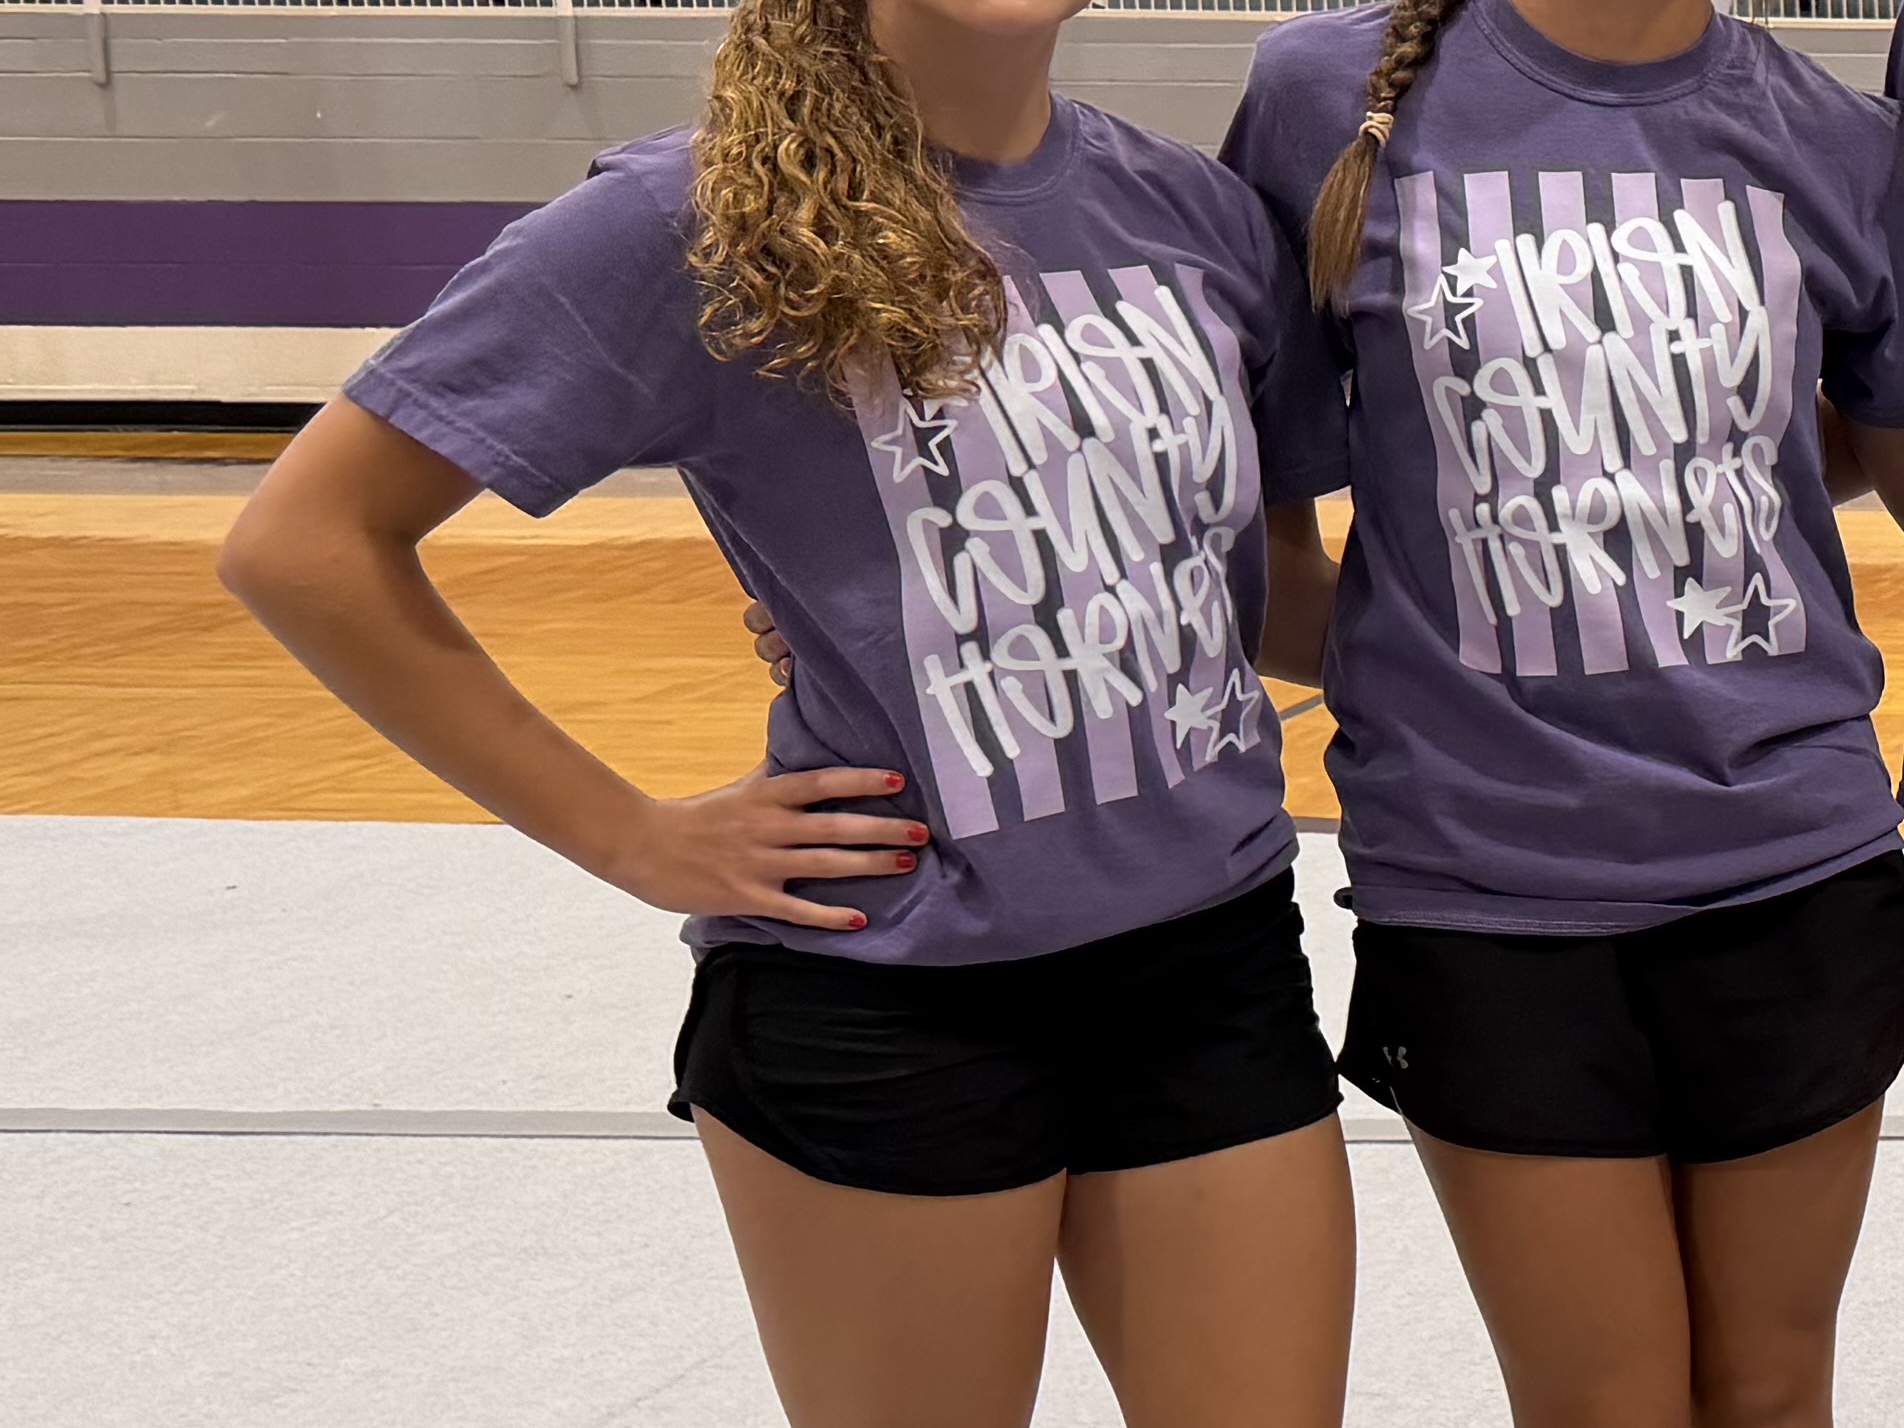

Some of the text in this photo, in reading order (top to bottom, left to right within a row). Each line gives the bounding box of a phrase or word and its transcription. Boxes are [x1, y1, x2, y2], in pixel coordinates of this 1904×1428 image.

[1494, 200, 1762, 359] IRION
[978, 285, 1228, 476] IRION
[1433, 305, 1772, 496] COUNTY
[907, 394, 1234, 634] COUNTY
